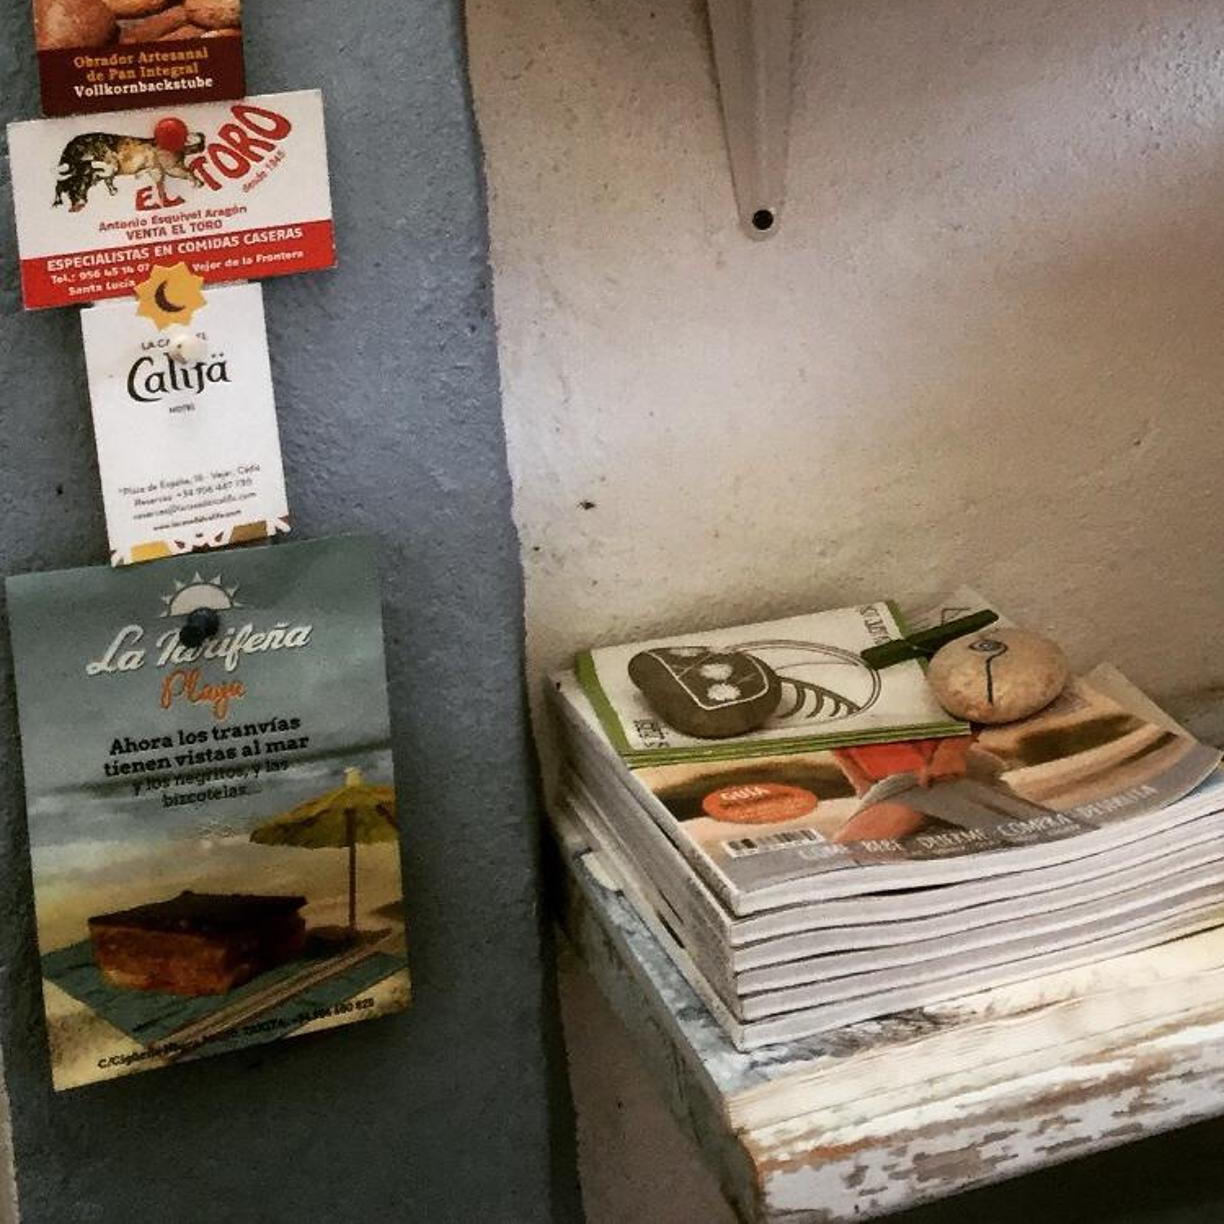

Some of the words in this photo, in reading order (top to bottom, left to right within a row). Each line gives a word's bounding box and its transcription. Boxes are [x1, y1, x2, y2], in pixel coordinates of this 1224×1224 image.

[73, 51, 134, 69] Obrador
[137, 46, 209, 64] Artesanal
[86, 70, 104, 82] de
[109, 67, 137, 81] Pan
[141, 62, 200, 79] Integral
[73, 76, 214, 98] Vollkornbackstube
[135, 185, 186, 212] EL
[189, 104, 293, 192] TORO
[98, 218, 148, 233] Antonio
[151, 210, 202, 227] Esquivel
[205, 205, 248, 219] Aragón
[126, 228, 167, 241] VENTA
[171, 225, 187, 235] EL
[190, 219, 223, 233] TORO
[47, 248, 150, 272] ESPECIALISTAS
[154, 243, 173, 257] EN
[178, 235, 240, 255] COMIDAS
[243, 227, 303, 246] CASERAS
[191, 260, 222, 272] Vejer
[224, 258, 240, 268] de
[242, 256, 254, 265] la
[255, 250, 305, 263] Frontera
[68, 284, 103, 296] Santa
[105, 277, 136, 291] Lucía
[79, 269, 101, 280] 956
[104, 266, 119, 277] 45
[85, 623, 146, 675] La
[160, 667, 247, 721] Playa
[109, 736, 174, 756] Ahora
[178, 729, 208, 746] los
[211, 716, 302, 741] tranvías
[103, 756, 172, 777] tienen
[175, 746, 238, 767] vistas
[241, 739, 262, 758] al
[266, 736, 310, 754] mar
[131, 782, 141, 797] y
[146, 776, 171, 791] los
[250, 761, 261, 779] y
[265, 758, 289, 773] las
